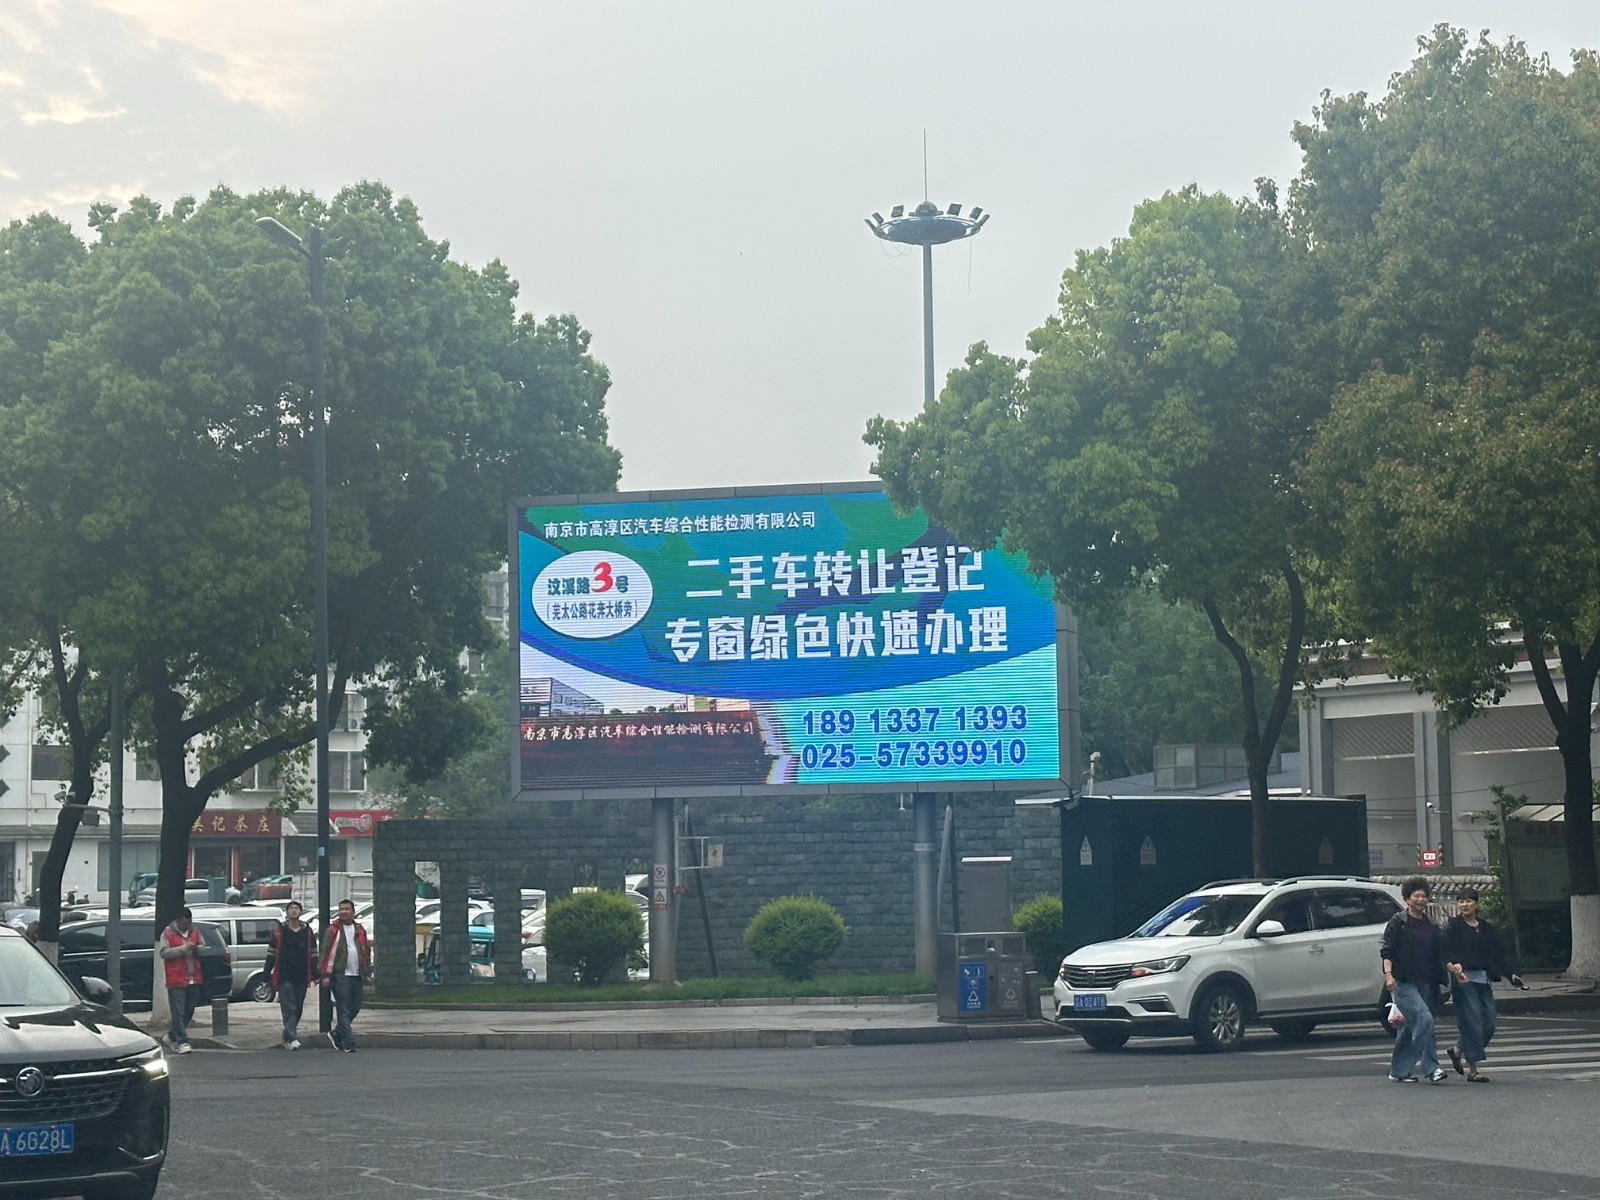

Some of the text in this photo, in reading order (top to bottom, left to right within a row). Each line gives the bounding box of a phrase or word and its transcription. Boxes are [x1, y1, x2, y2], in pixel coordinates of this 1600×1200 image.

[545, 511, 816, 539] 南京市高淳区汽车综合性能检测有限公司
[685, 545, 985, 599] 二手车转让登记
[665, 606, 1008, 662] 专窗绿色快速办理
[523, 721, 755, 743] 南京市高淳区汽车综合性能检测有限公司
[802, 704, 1028, 736] 189 1337 1393
[802, 738, 1027, 770] 025-57339910
